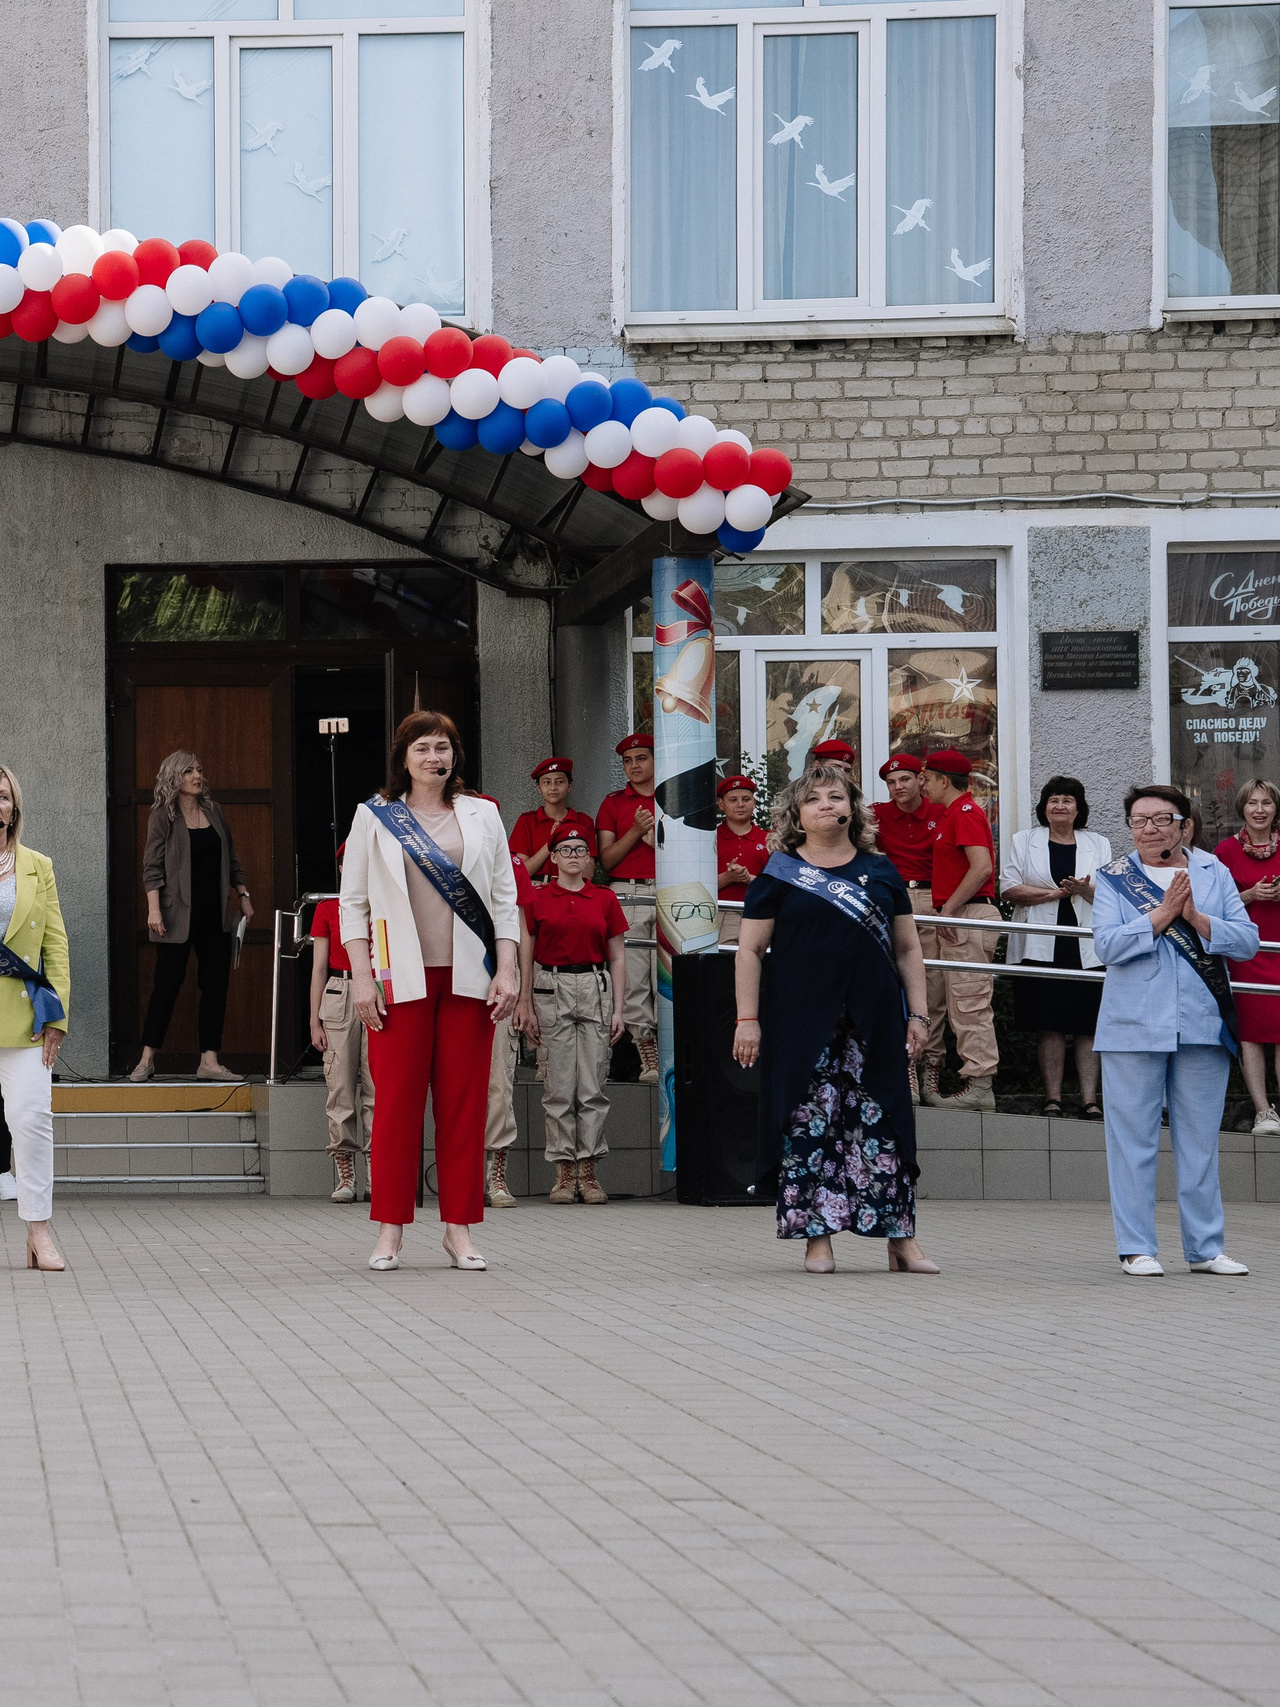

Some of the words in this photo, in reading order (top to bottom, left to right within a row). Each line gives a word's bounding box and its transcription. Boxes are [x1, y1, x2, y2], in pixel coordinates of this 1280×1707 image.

[1186, 718, 1236, 730] СПАСИБО
[1238, 717, 1267, 730] ДЕДУ
[1193, 732, 1208, 743] ЗА
[1214, 731, 1260, 743] ПОБЕДУ!
[391, 803, 430, 851] Классный
[399, 834, 450, 892] руководитель
[446, 887, 481, 922] 2025
[827, 881, 873, 917] Классный
[1125, 873, 1162, 908] Классн
[1197, 955, 1227, 995] 2025
